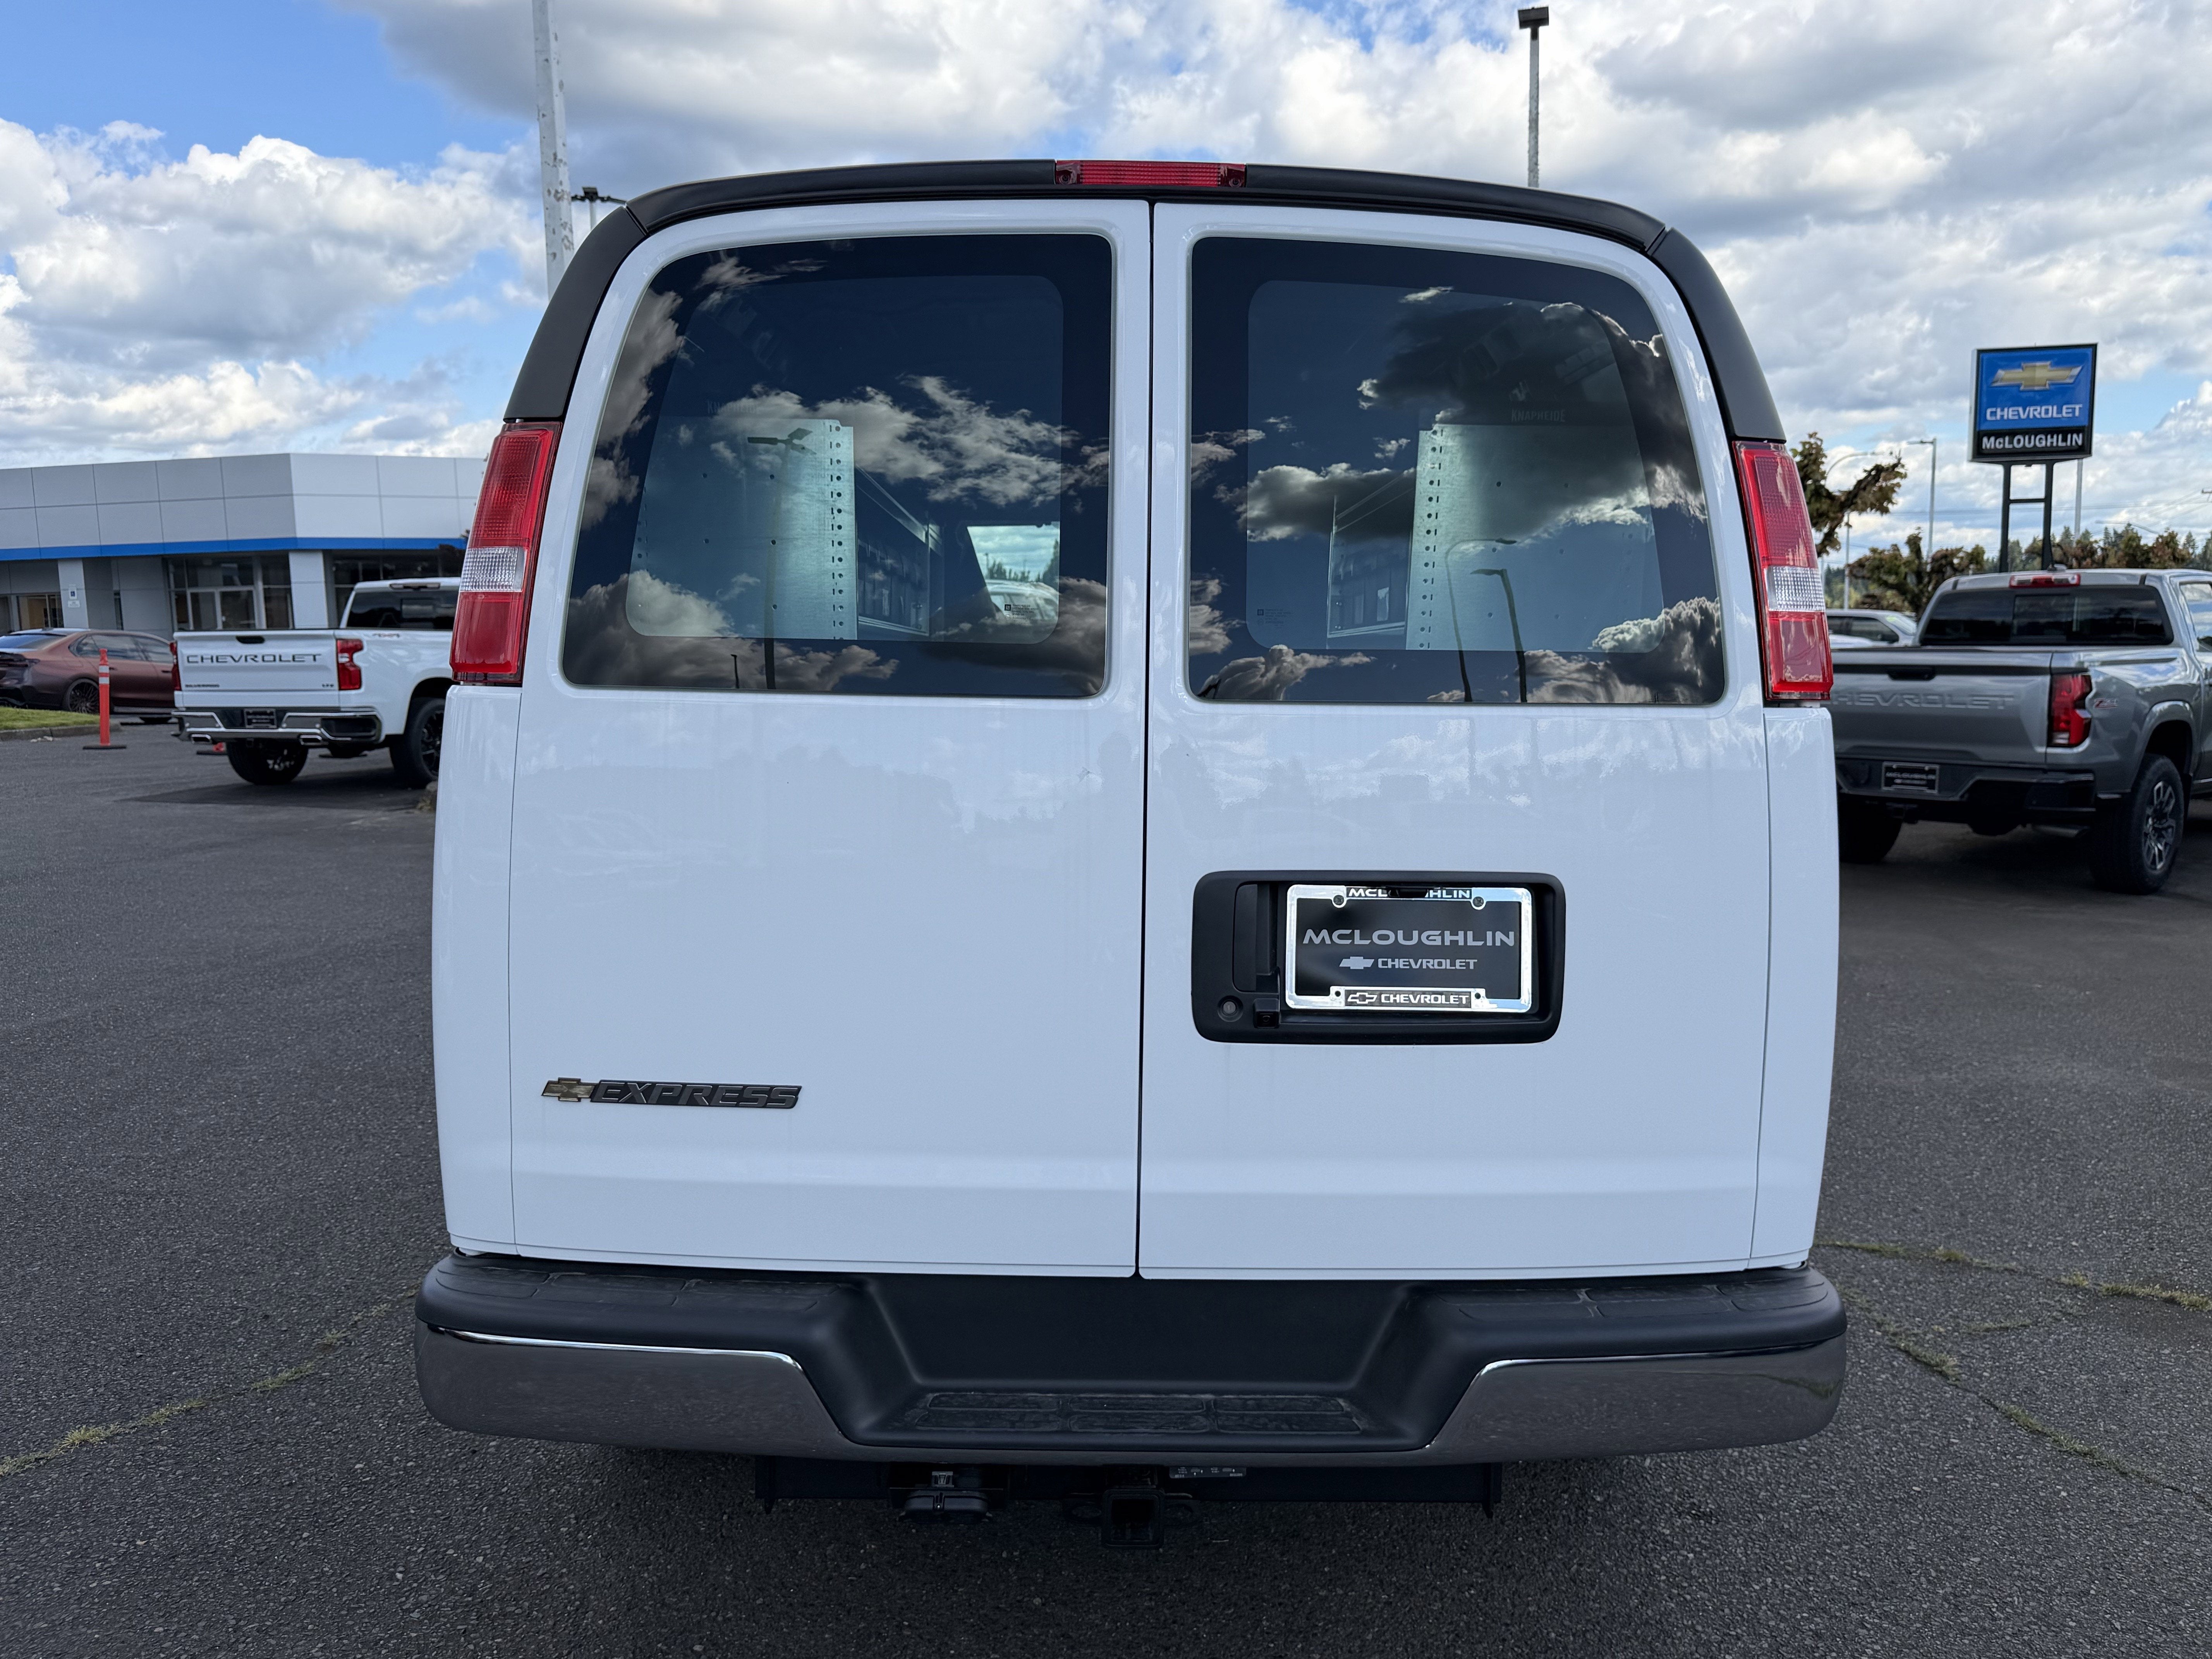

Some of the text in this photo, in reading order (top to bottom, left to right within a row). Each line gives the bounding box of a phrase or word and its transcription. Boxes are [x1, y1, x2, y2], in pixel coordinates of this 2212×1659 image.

[1511, 409, 1566, 422] KNAPHEIDE
[1986, 404, 2083, 421] CHEVROLET
[1982, 433, 2083, 449] McLOUGHLIN
[186, 653, 322, 663] CHEVROLET
[1820, 692, 2013, 709] HEVROLET
[1348, 888, 1470, 898] MCLHLIN
[1302, 929, 1515, 946] MCLOUGHLIN
[1378, 958, 1477, 970] CHEVROLET
[1381, 994, 1469, 1004] CHEVROLET
[592, 1082, 799, 1108] EXPRESS
